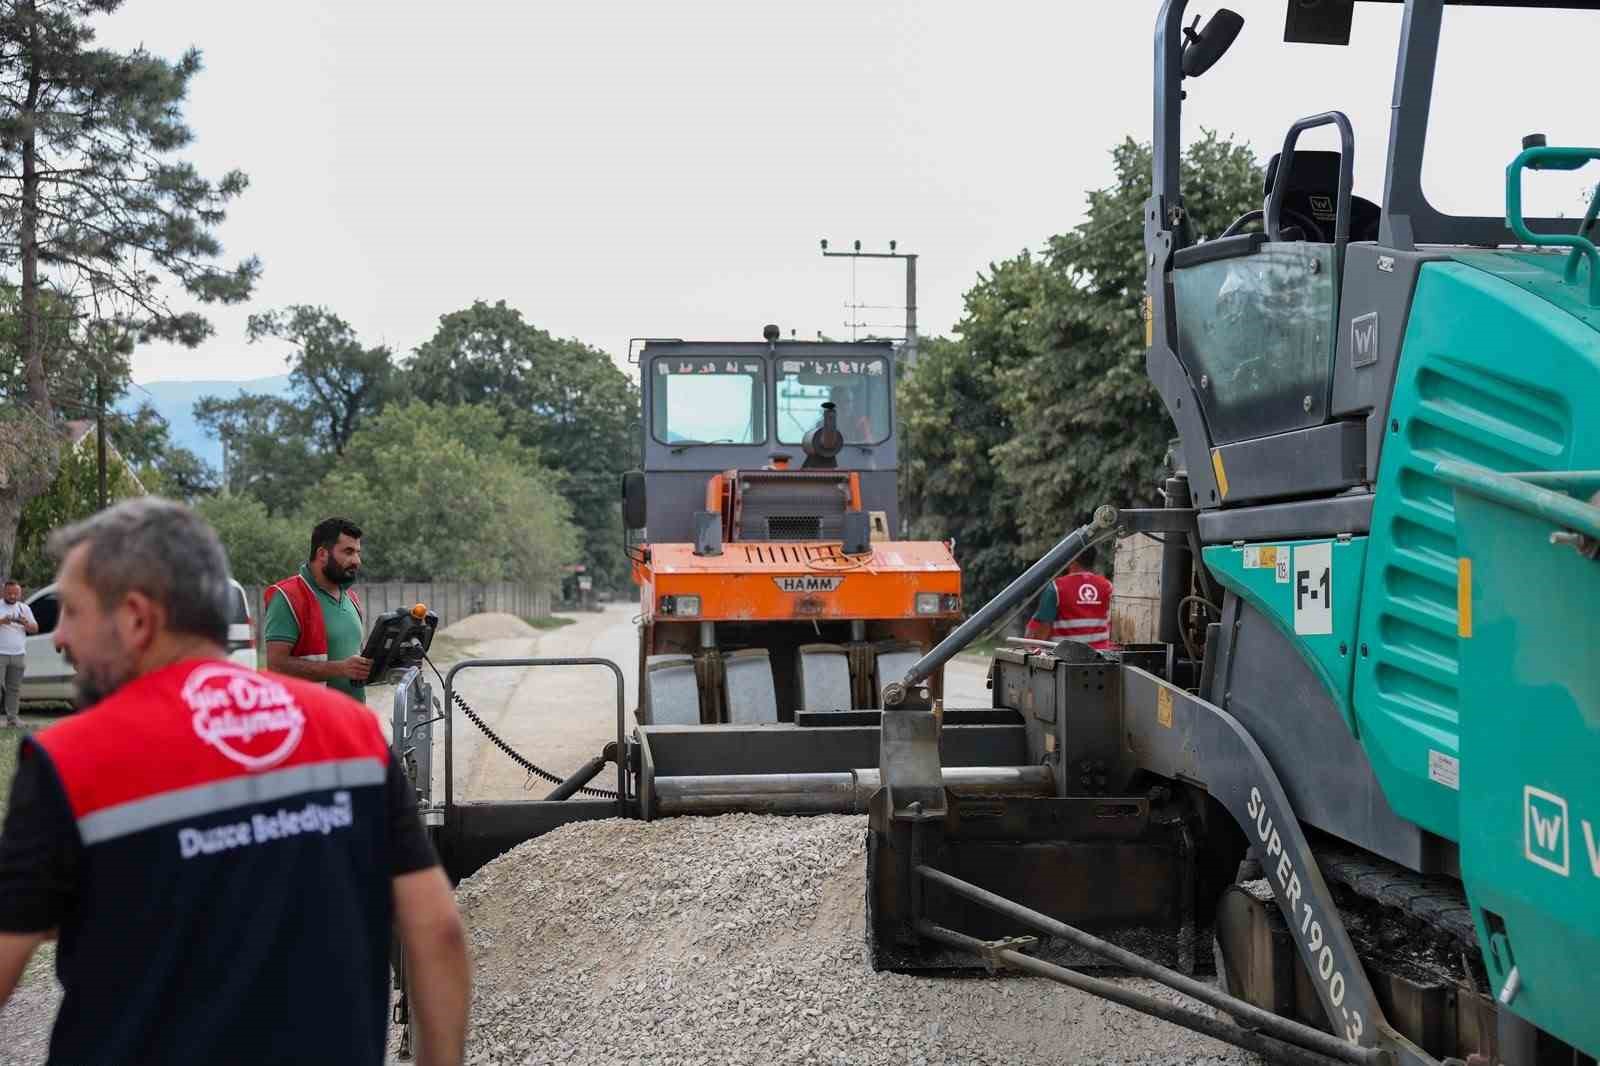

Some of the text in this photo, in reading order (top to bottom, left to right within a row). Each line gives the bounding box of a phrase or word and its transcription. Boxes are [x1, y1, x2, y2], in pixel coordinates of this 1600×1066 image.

[1355, 324, 1373, 354] W
[784, 578, 833, 590] HAMM
[1297, 567, 1330, 610] F-1
[1531, 805, 1562, 852] W
[1247, 786, 1363, 1046] SUPER 1900-3
